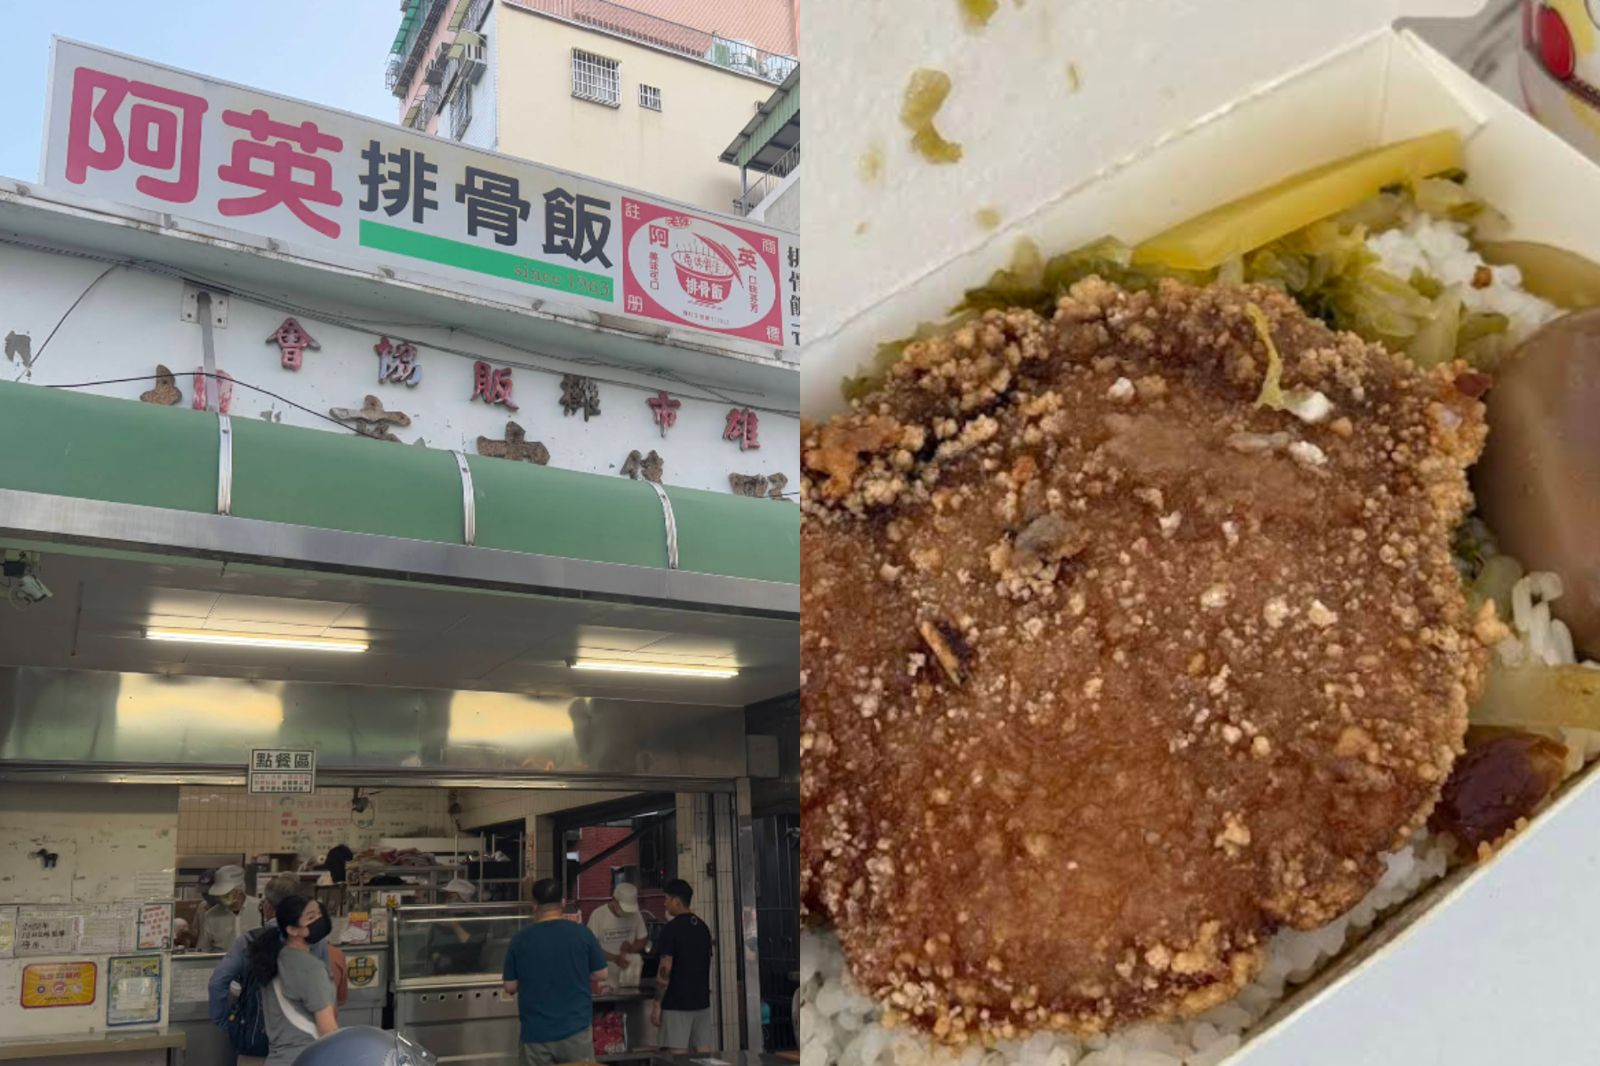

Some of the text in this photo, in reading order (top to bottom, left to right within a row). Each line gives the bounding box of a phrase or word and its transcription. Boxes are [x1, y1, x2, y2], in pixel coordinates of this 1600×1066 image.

[625, 202, 641, 221] 註
[649, 224, 669, 248] 阿
[762, 238, 776, 255] 商
[737, 247, 757, 271] 英
[514, 262, 561, 286] since
[685, 277, 723, 301] 排骨飯
[627, 294, 643, 313] 冊
[256, 752, 310, 769] 點餐區
